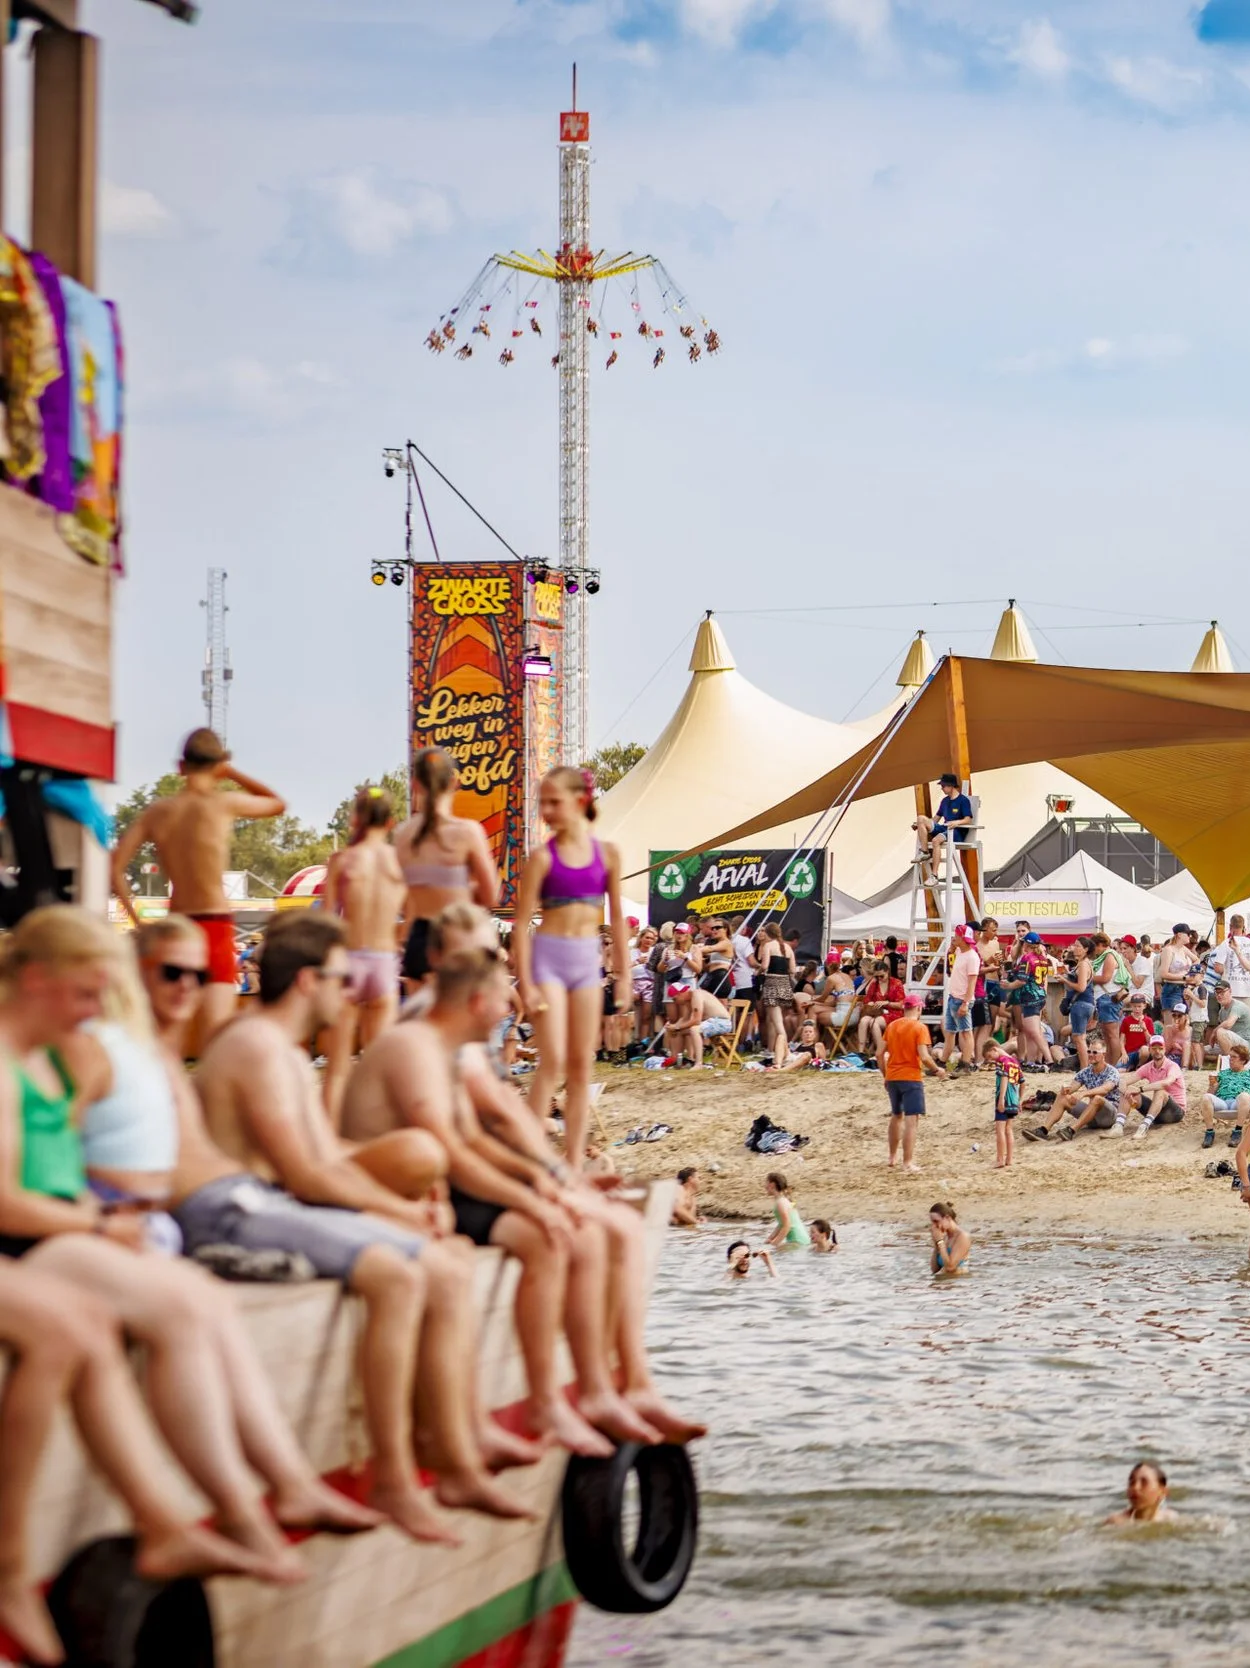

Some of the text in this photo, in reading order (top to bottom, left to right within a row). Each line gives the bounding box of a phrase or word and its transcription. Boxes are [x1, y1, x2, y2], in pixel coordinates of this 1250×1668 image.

[427, 577, 512, 601] ZWARTE
[433, 591, 506, 616] CROSS
[416, 689, 506, 728] Lekker
[434, 716, 506, 742] weg in
[699, 862, 769, 893] AFVAL
[1027, 902, 1079, 916] TESTLAB
